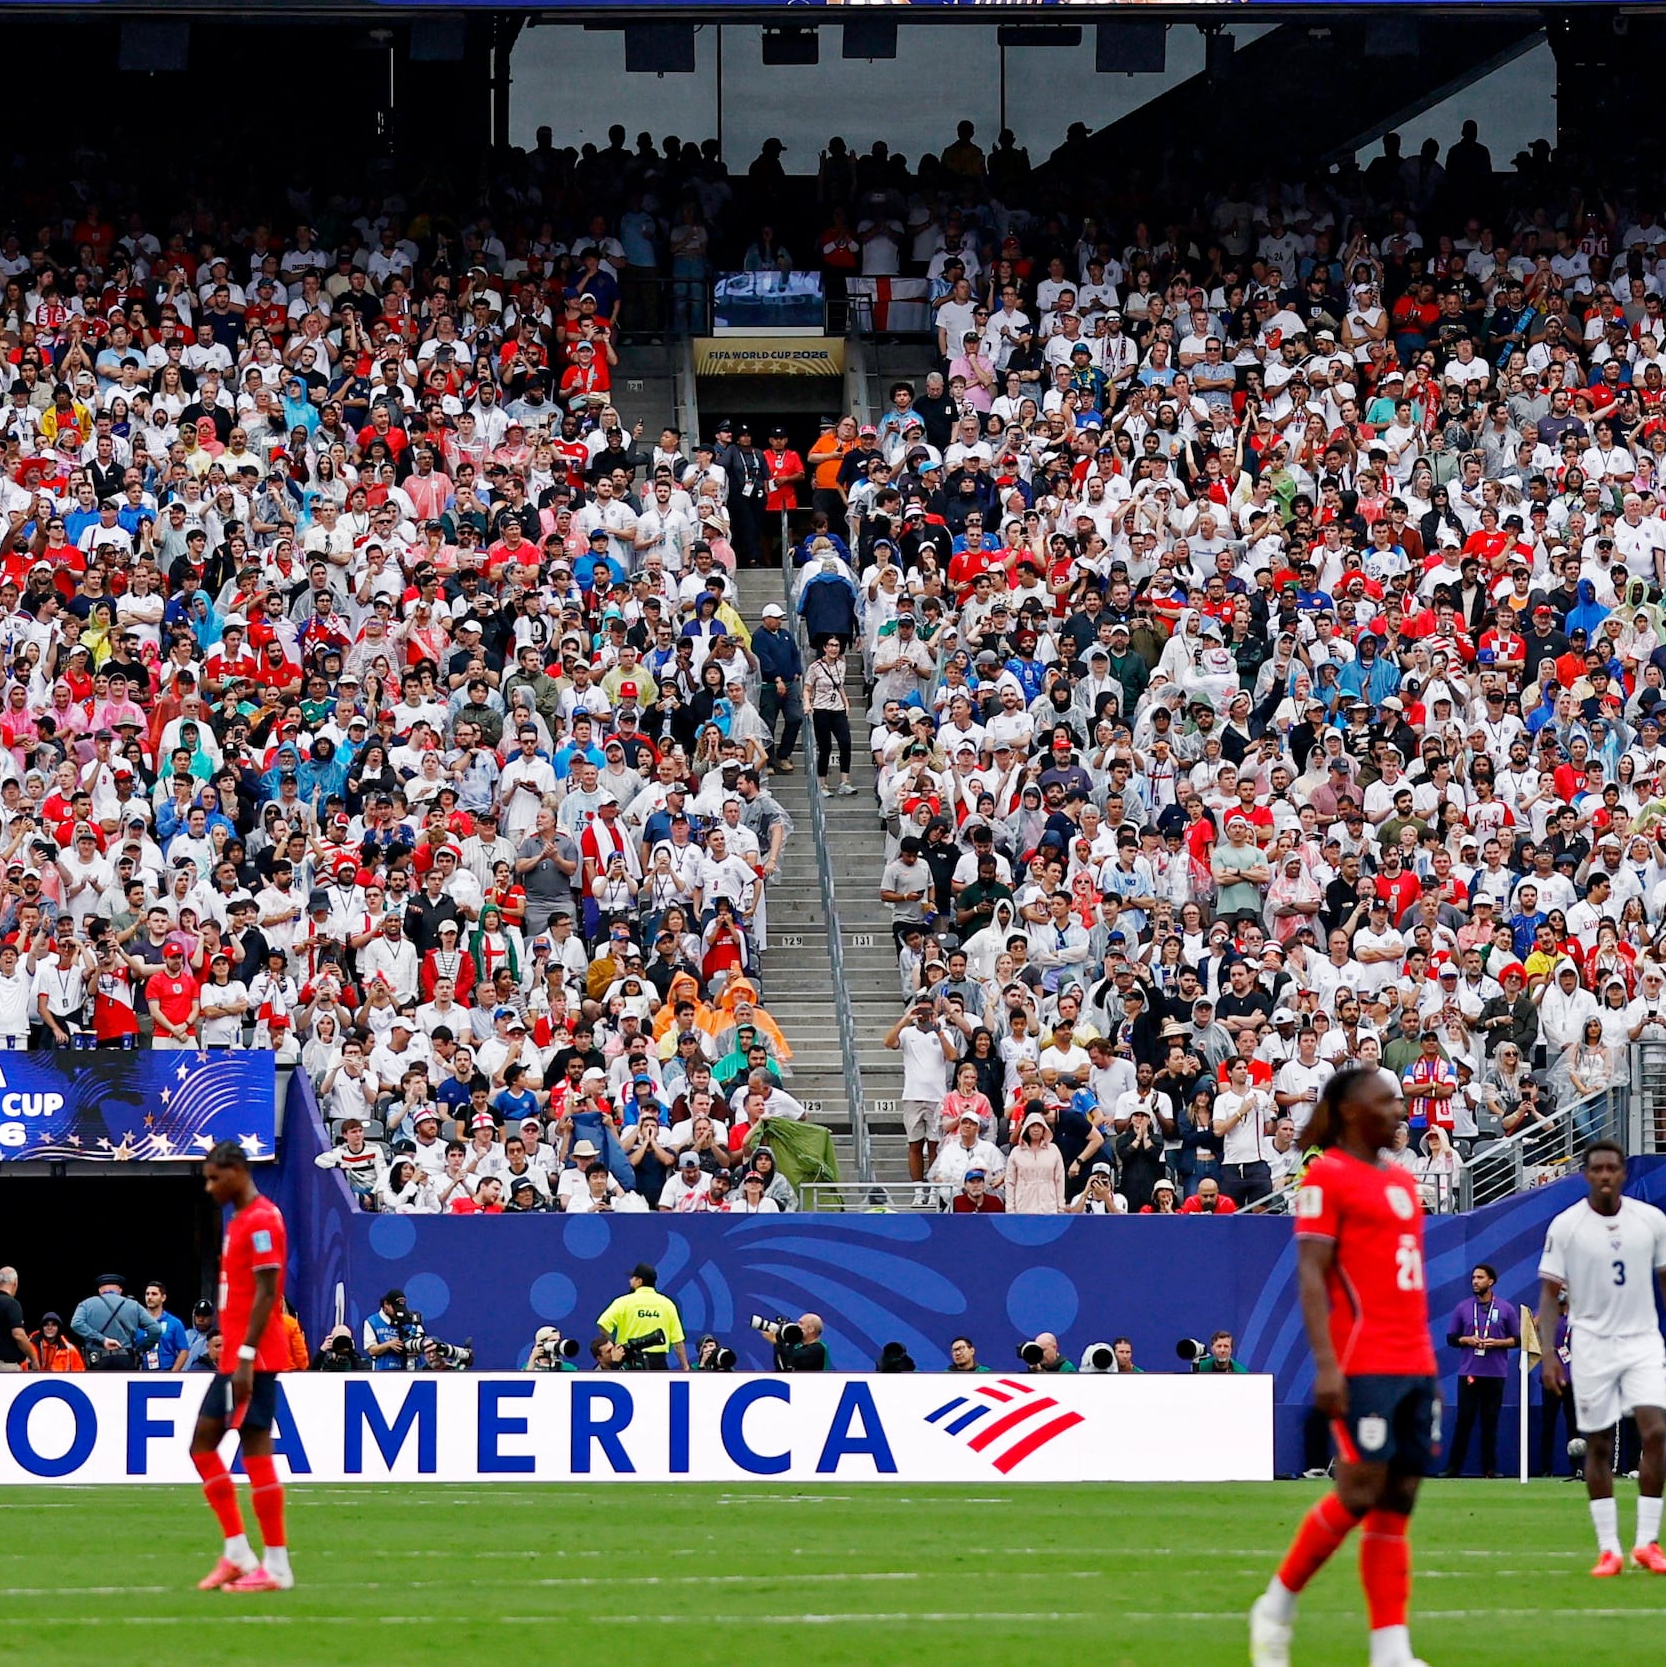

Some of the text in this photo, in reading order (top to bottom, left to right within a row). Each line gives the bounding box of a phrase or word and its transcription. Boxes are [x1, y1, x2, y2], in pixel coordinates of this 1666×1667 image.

[709, 350, 829, 359] FIFA WORLD CUP 2026
[784, 936, 803, 945] 129
[854, 936, 871, 945] 131
[3, 1093, 65, 1118] CUP
[877, 1101, 895, 1111] 131
[1612, 1260, 1626, 1285] 3
[637, 1309, 660, 1319] 644
[6, 1379, 183, 1477] OF
